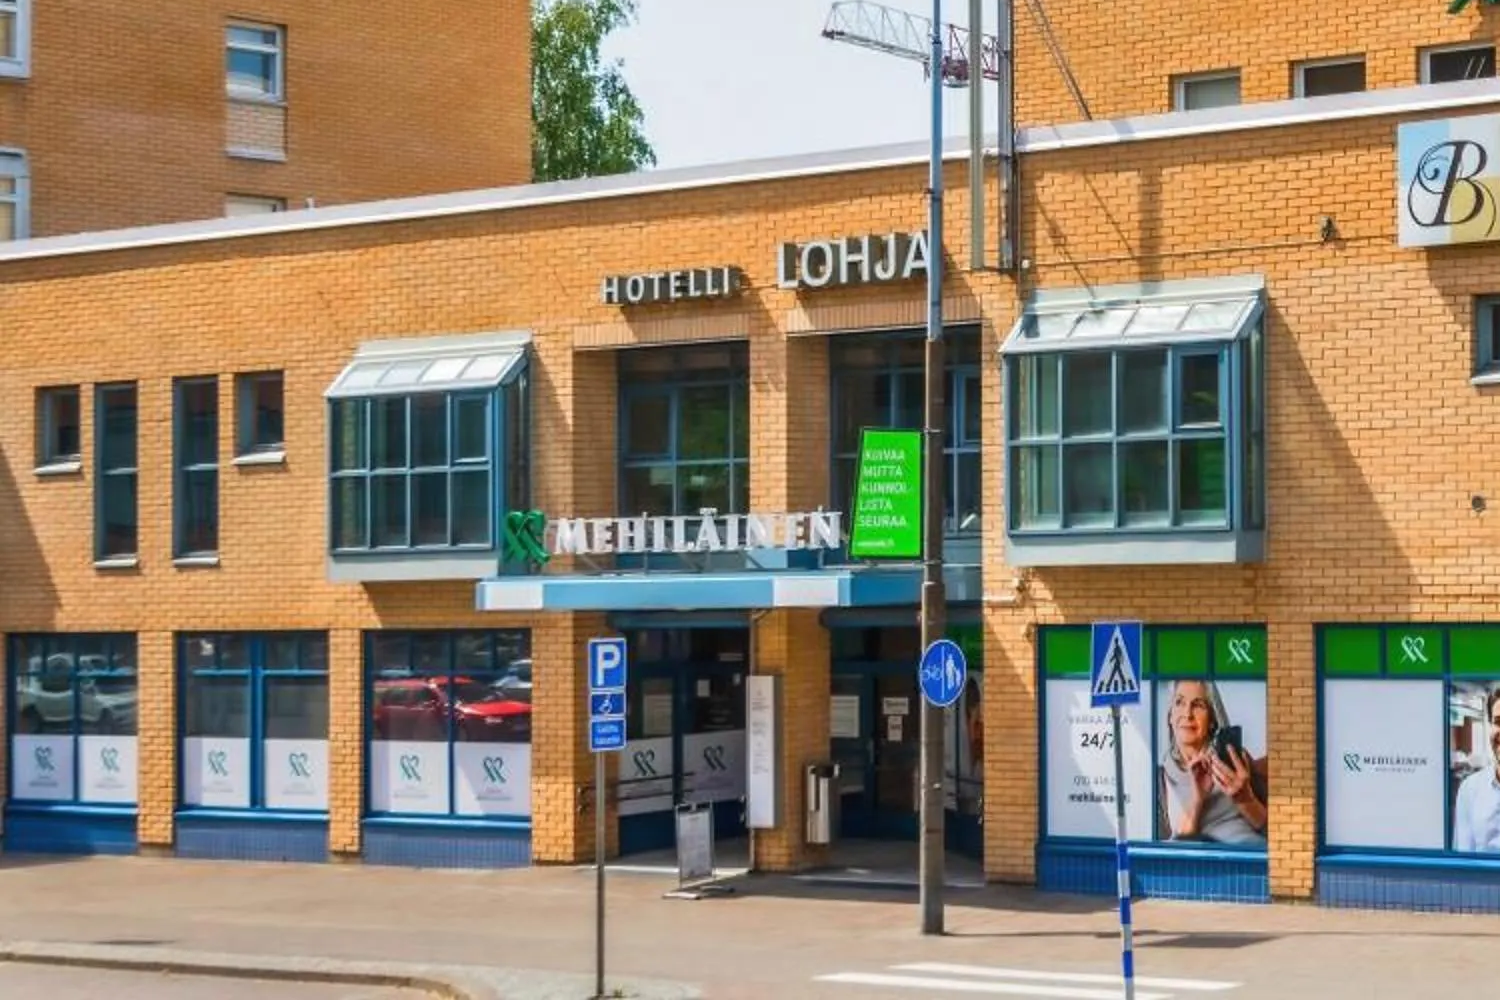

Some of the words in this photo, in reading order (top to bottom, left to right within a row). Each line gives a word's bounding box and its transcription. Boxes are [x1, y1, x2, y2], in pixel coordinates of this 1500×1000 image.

[602, 266, 732, 304] HOTELLI
[777, 230, 932, 290] LOHJA
[554, 506, 842, 555] MEHILÄINEN
